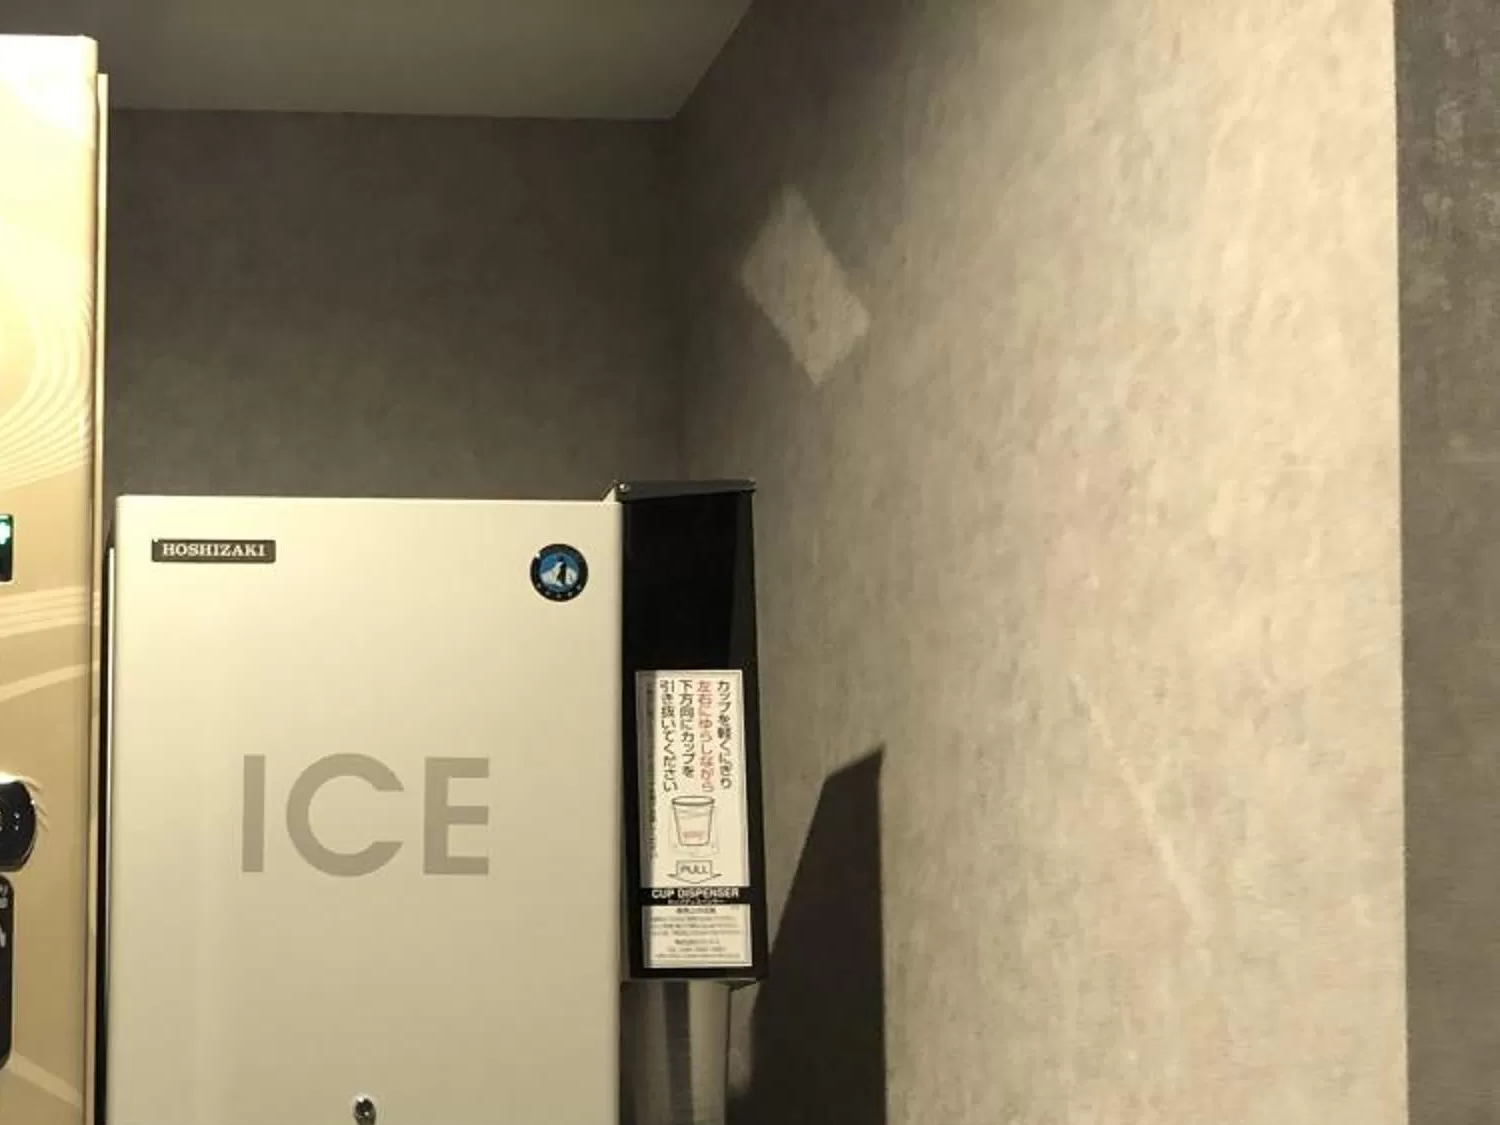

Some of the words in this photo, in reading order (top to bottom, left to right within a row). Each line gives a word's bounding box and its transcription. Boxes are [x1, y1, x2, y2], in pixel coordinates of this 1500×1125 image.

[162, 542, 266, 558] HOSHIZAKI
[242, 753, 489, 877] ICE
[651, 888, 675, 899] CUP
[677, 887, 740, 899] DISPENSER
